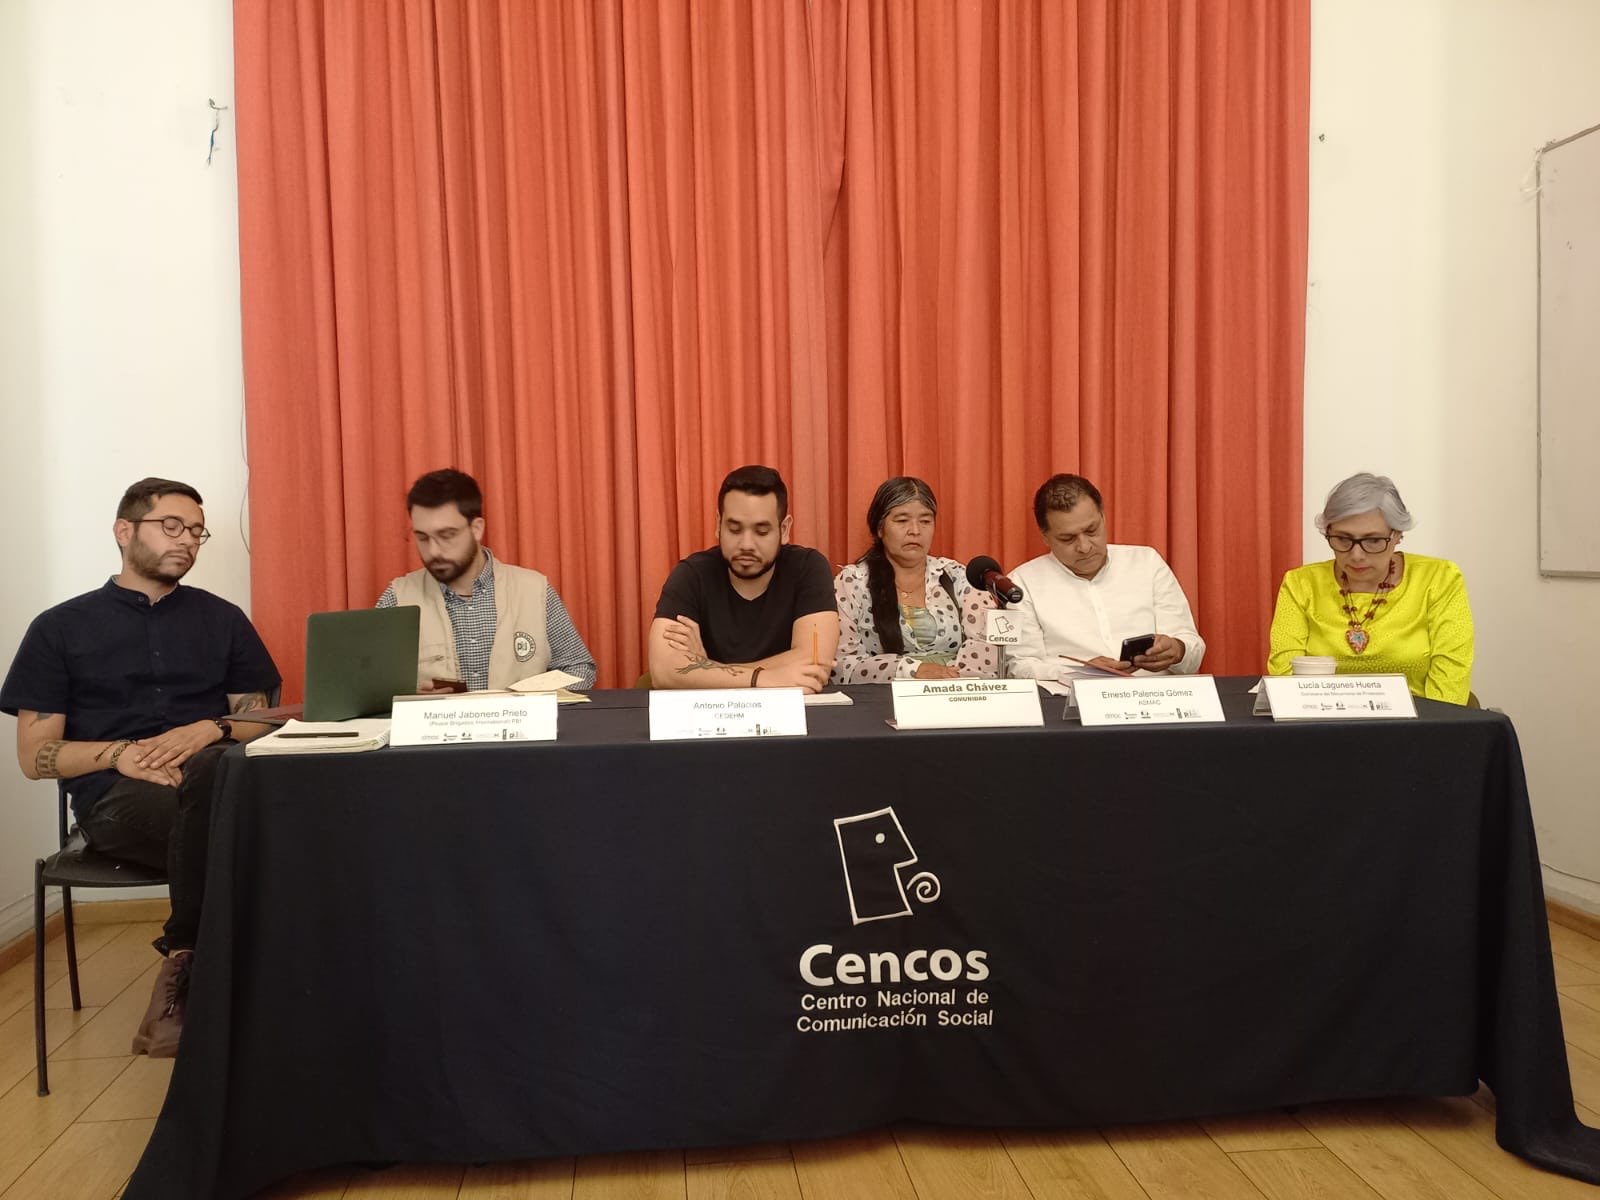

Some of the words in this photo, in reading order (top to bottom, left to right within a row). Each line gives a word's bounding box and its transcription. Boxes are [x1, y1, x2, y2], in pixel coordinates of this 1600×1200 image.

[923, 684, 963, 693] Amada
[966, 682, 1008, 692] Chávez
[1321, 681, 1354, 690] Lagunes
[1356, 680, 1382, 689] Huerta
[1101, 690, 1131, 699] Ernesto
[1132, 690, 1165, 698] Palencia
[693, 702, 725, 710] Antonio
[727, 701, 762, 709] Palacios
[424, 711, 457, 720] Manuel
[458, 711, 500, 719] Jabonero
[502, 709, 528, 717] Prieto
[799, 943, 990, 987] Cencos
[801, 993, 867, 1011] Centro
[877, 989, 956, 1007] Nacional
[966, 988, 989, 1004] de
[797, 1008, 927, 1032] Comunicación
[937, 1010, 993, 1026] Social
